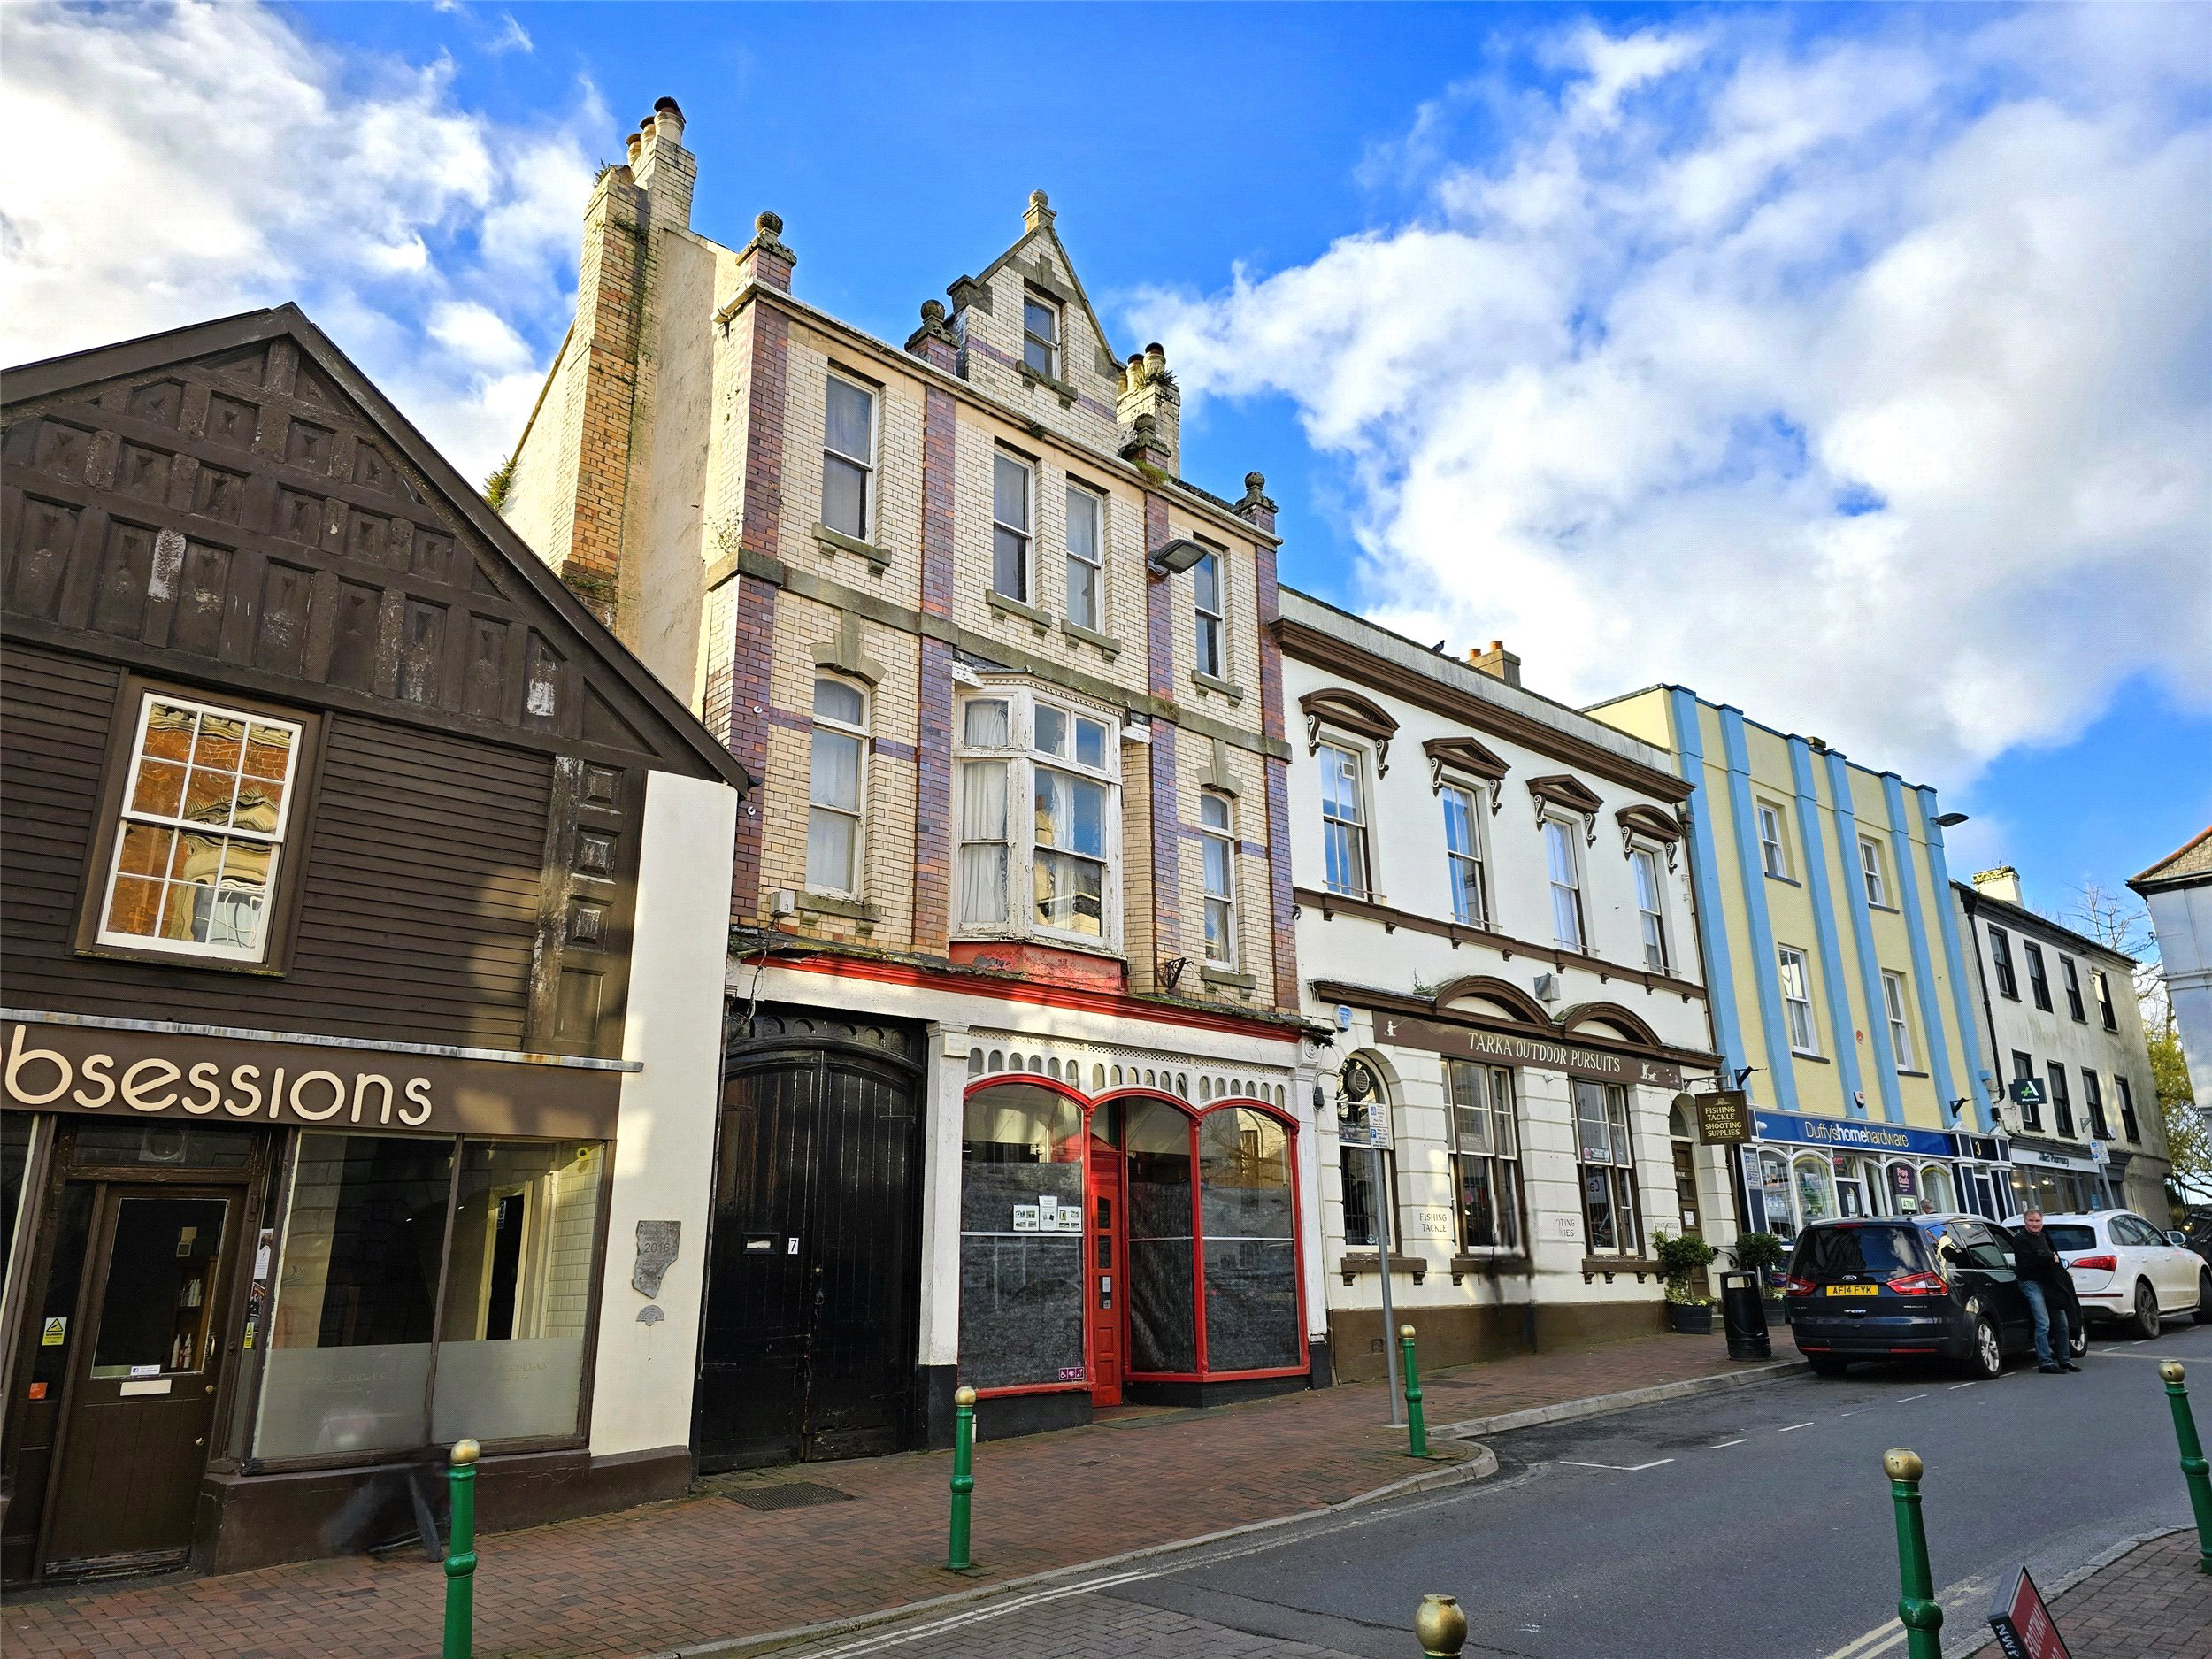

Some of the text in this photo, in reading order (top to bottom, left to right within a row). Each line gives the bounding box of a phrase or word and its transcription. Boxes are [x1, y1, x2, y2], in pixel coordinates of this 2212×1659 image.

[1468, 1032, 1621, 1073] TARKA OUTDOOR PURSUITS
[0, 1025, 432, 1126] bsessions
[1975, 1141, 1981, 1155] 3
[1419, 1213, 1447, 1222] FISHING
[1422, 1224, 1447, 1233] TACKLE
[644, 1242, 670, 1253] 2016
[790, 1240, 797, 1252] 7
[2024, 1600, 2047, 1659] FOOTWAY
